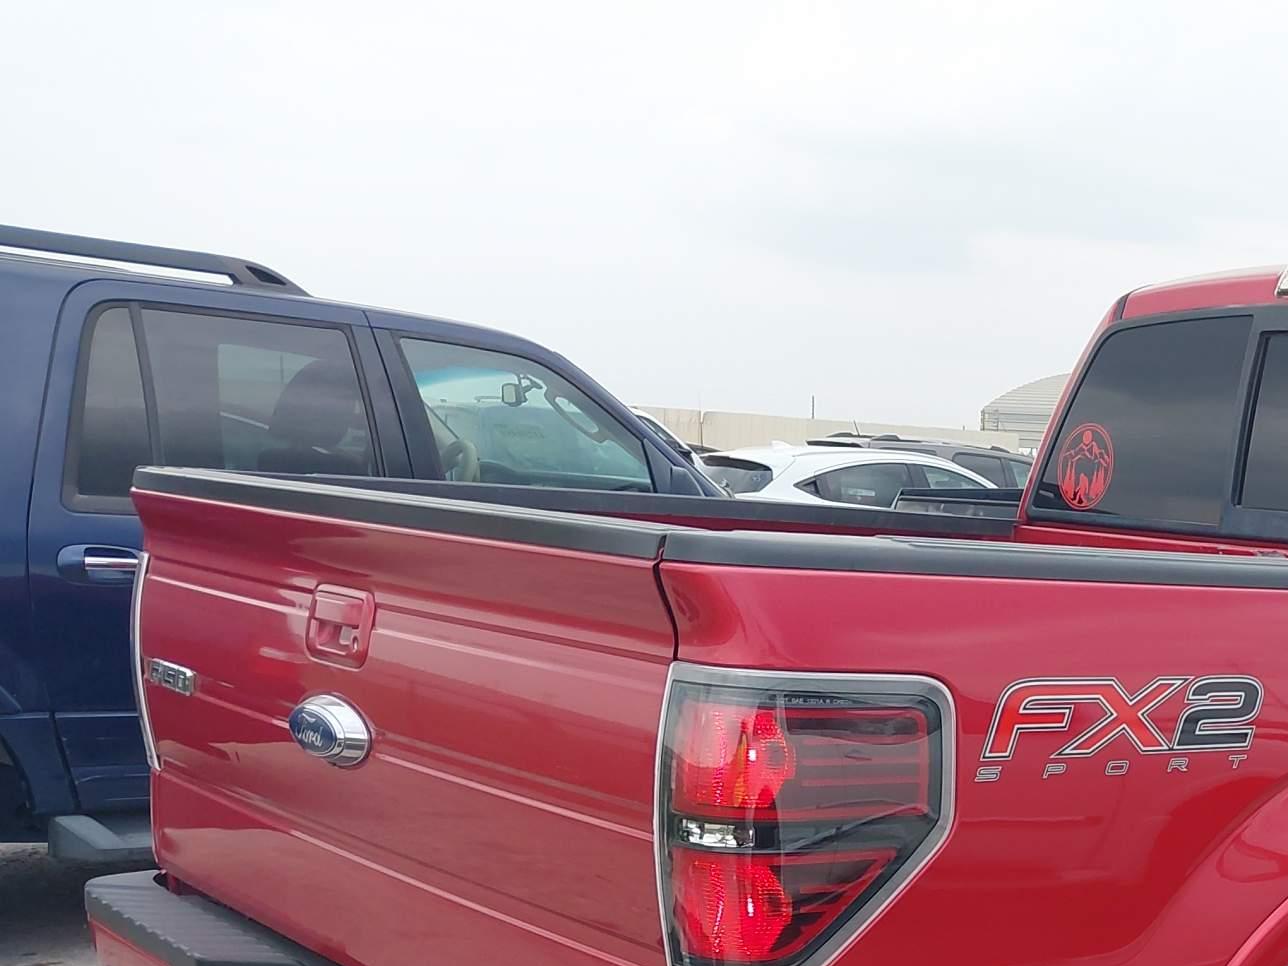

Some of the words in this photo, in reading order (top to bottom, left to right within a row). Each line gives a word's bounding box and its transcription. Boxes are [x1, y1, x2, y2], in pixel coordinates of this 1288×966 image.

[295, 712, 324, 748] Ford
[980, 675, 1264, 761] FX2
[974, 754, 1248, 782] SPORT
